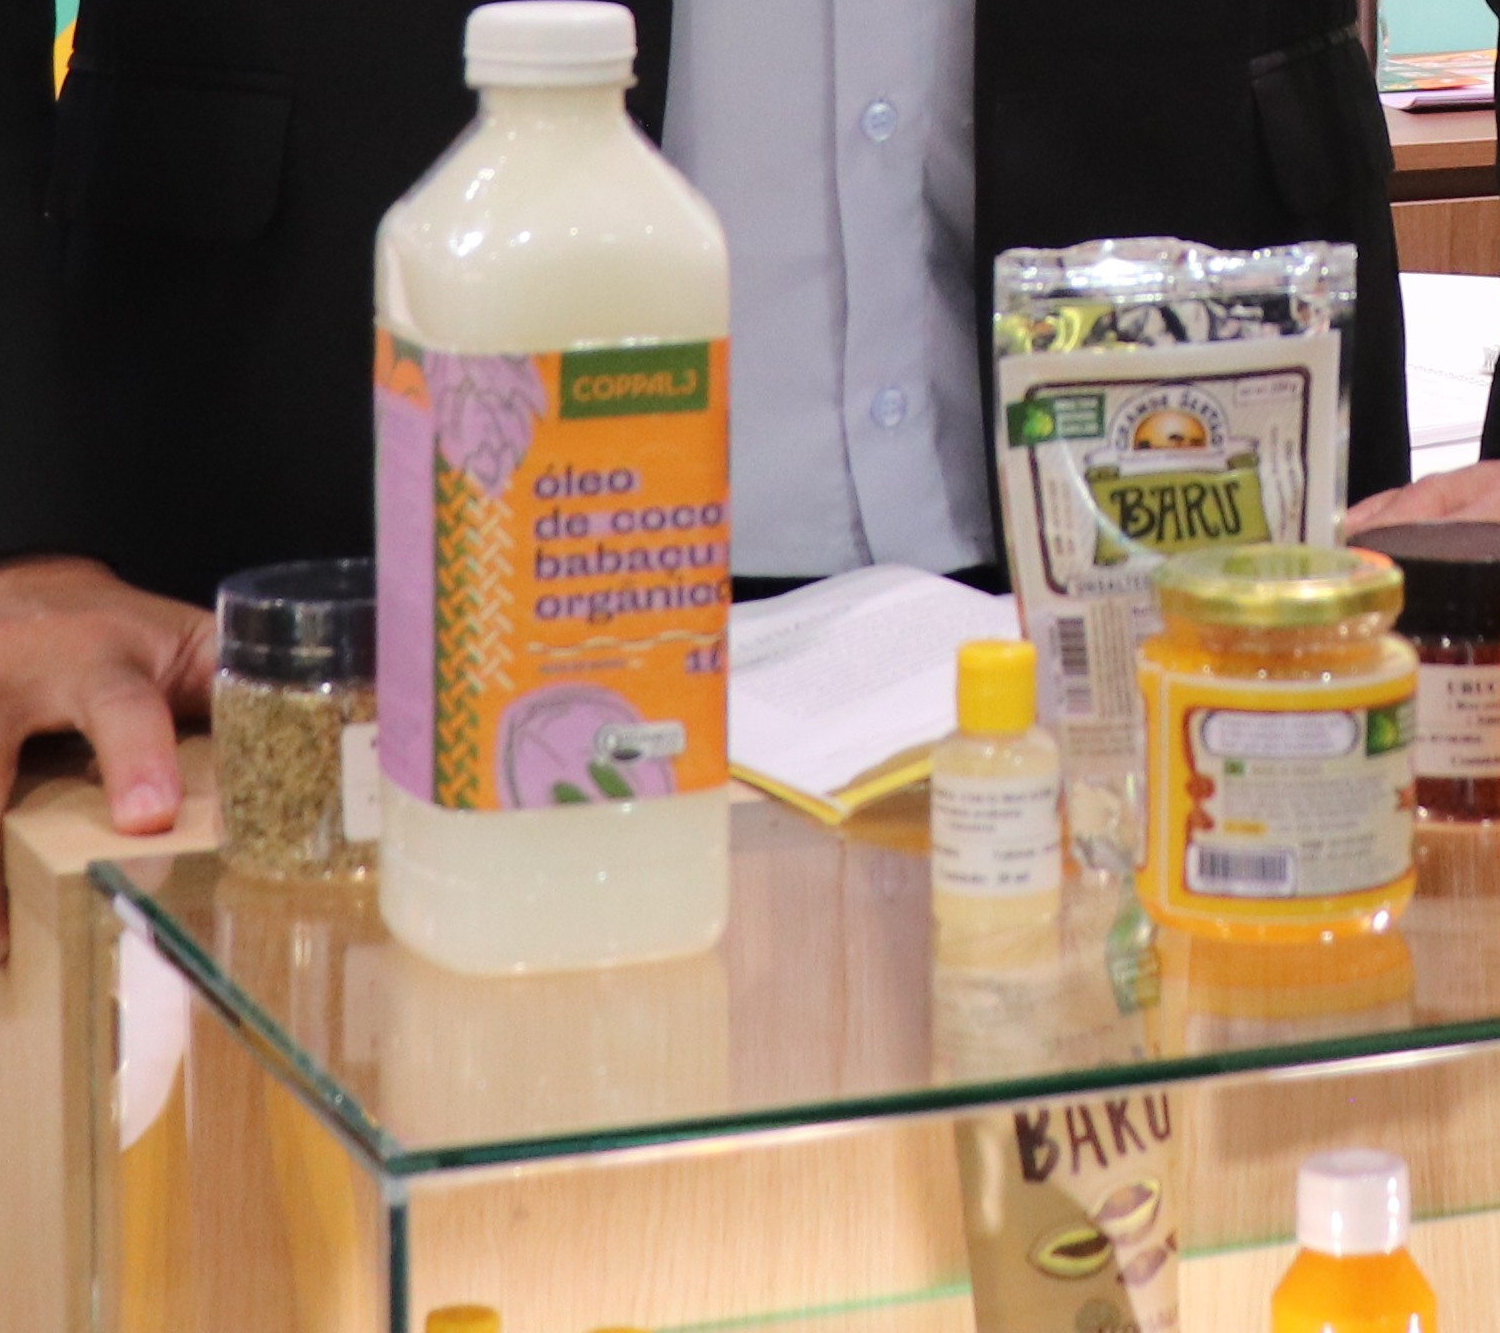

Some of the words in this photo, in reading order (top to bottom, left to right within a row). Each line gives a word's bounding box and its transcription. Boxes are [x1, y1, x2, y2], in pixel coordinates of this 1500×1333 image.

[571, 367, 698, 402] COPPALJ
[1115, 395, 1169, 451] GRANDE
[533, 463, 636, 499] óleo
[535, 508, 590, 541] de
[610, 501, 724, 535] coco
[1110, 480, 1242, 543] BARU
[535, 540, 718, 580] babaçu
[535, 573, 732, 625] orgânico
[1447, 681, 1496, 694] URUC
